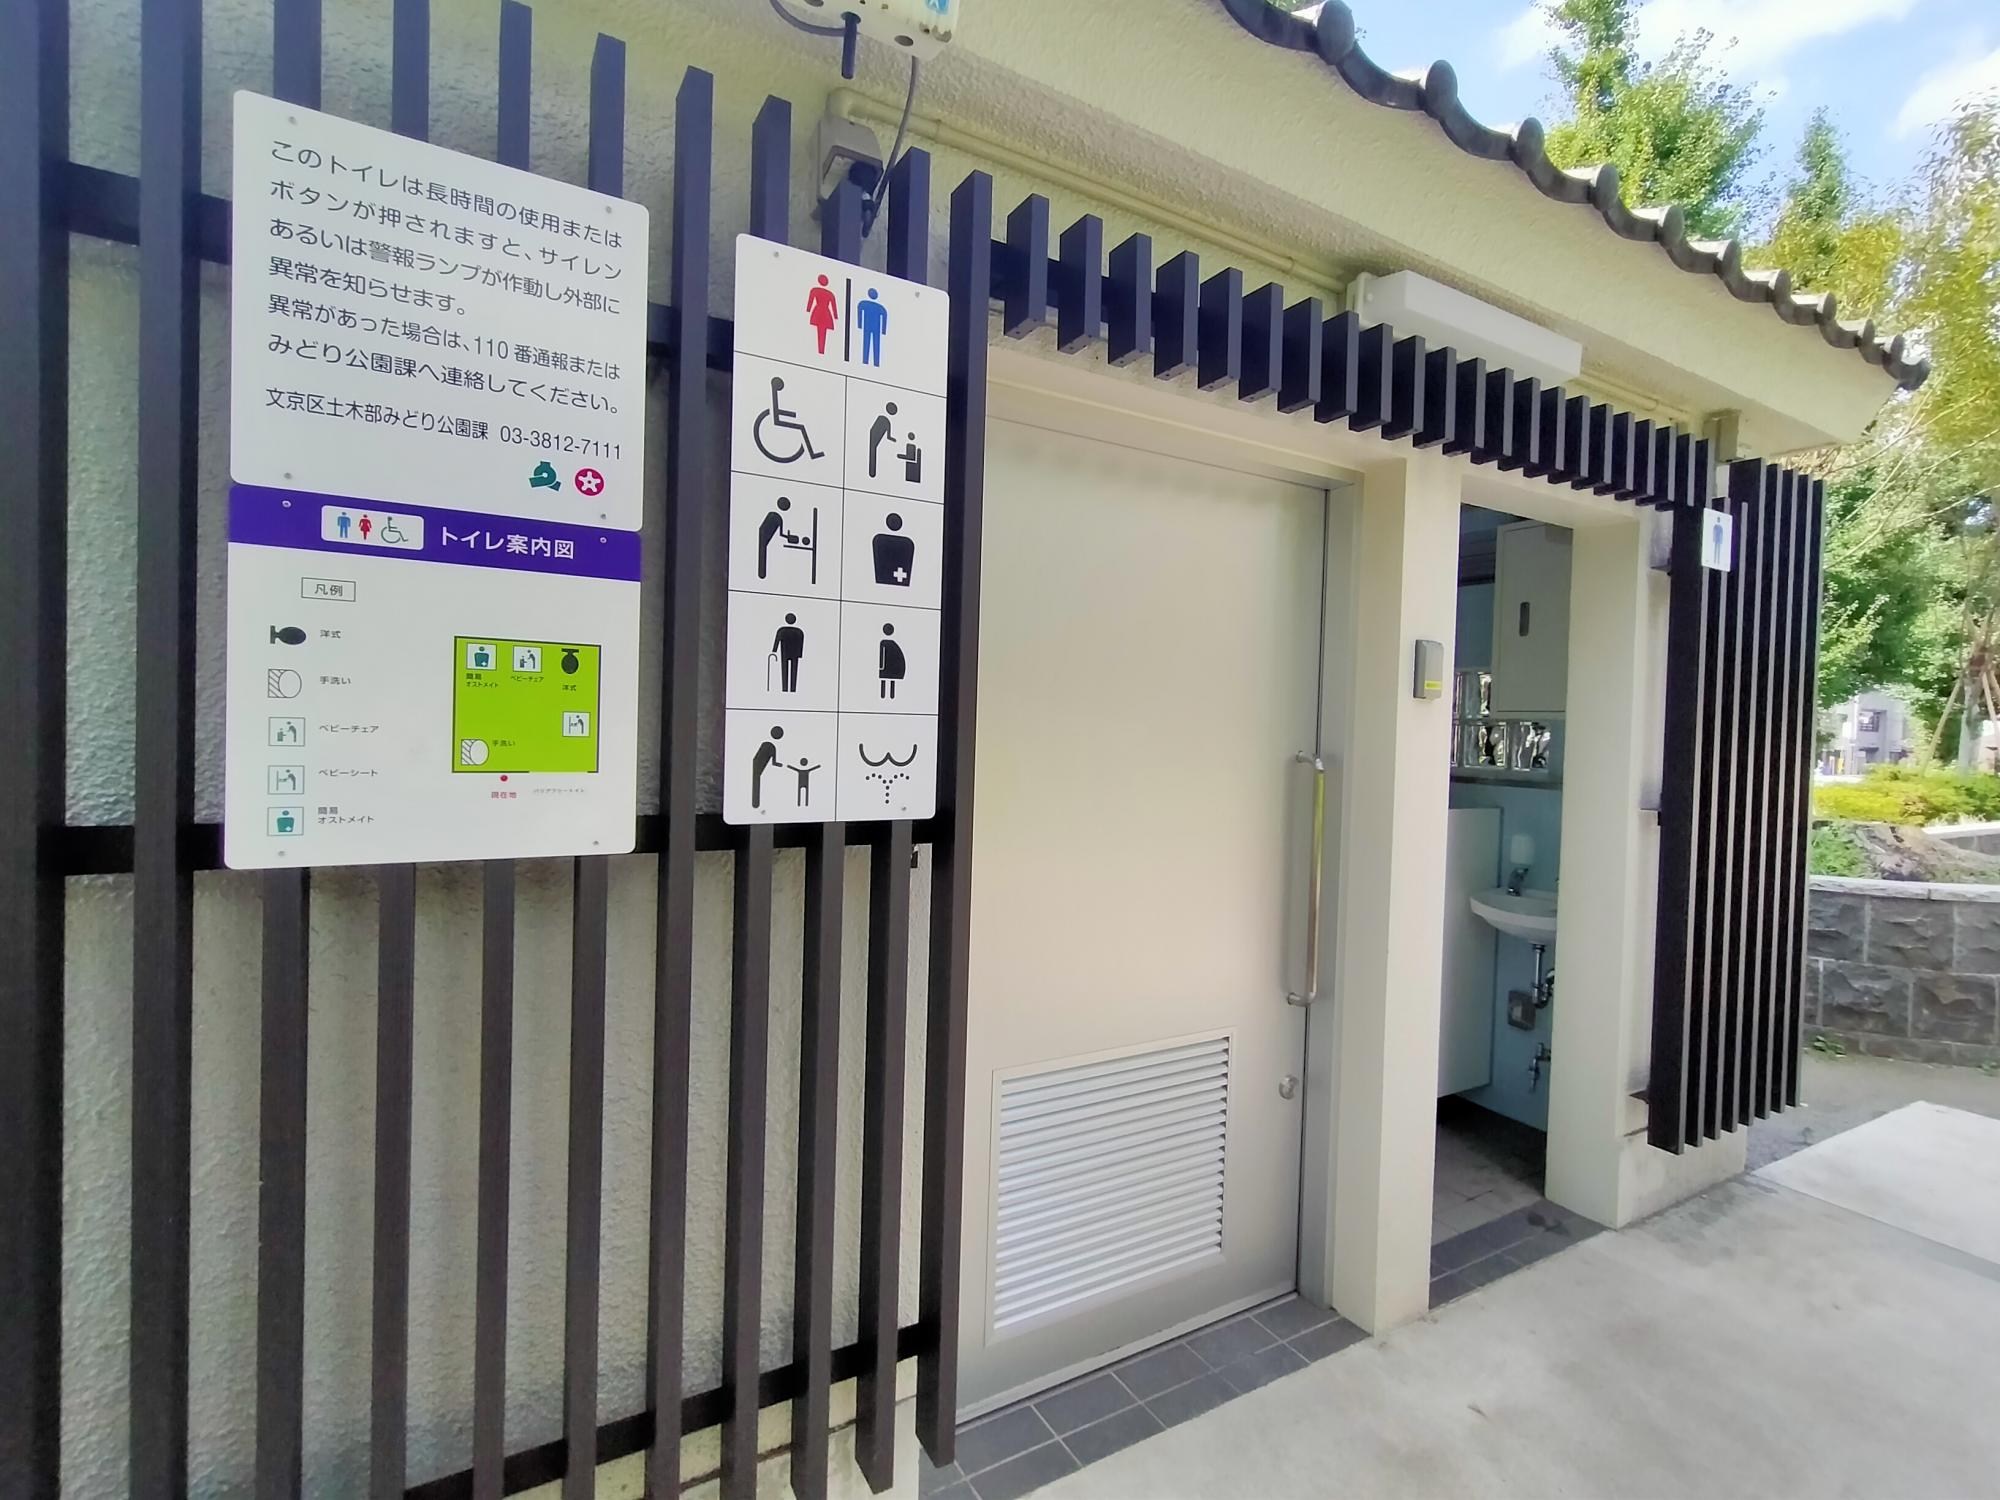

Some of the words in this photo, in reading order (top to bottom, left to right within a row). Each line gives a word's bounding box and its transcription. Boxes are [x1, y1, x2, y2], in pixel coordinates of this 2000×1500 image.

[271, 140, 623, 249] このトイレは長時間の使用または
[270, 180, 622, 280] ボタンが押されますと、サイレン
[269, 218, 620, 315] あるいは警報ランプが作動し外部に
[269, 255, 466, 316] 異常を知らせます。
[268, 333, 619, 414] みどり公園課へ連絡してください。
[265, 387, 489, 441] 文京区土木部みどり公園課
[499, 425, 622, 460] 03-3812-7111
[442, 526, 574, 559] トイレ案内図
[314, 583, 343, 597] 凡例
[319, 629, 341, 639] 洋式
[320, 675, 351, 686] 手洗い
[319, 724, 380, 734] ベビーチェア
[318, 769, 379, 778] ベビーシート
[317, 815, 375, 825] オストメイト
